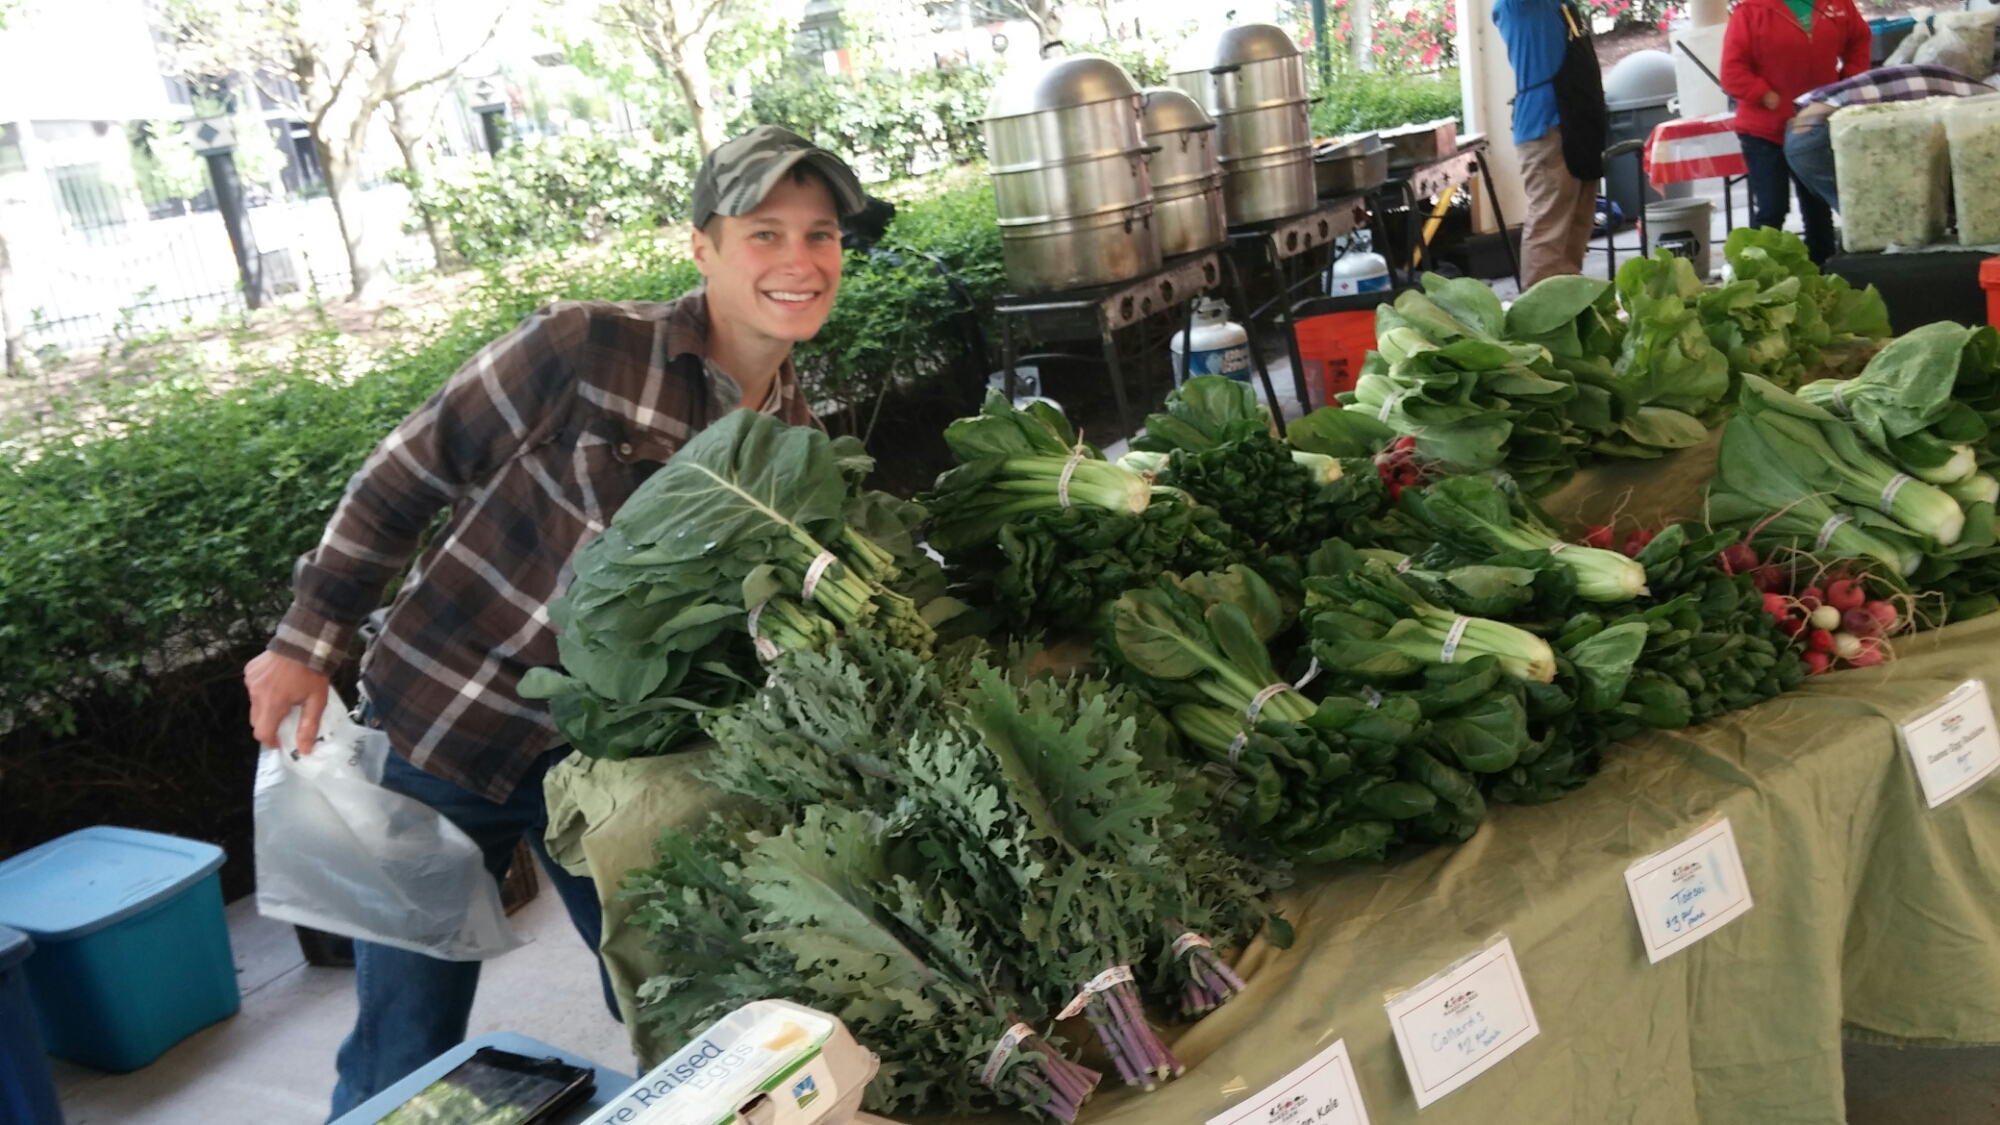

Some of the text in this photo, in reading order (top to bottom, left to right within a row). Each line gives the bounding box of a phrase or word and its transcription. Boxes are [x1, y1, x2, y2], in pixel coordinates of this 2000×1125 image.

[1670, 881, 1705, 906] Tatsoi
[1431, 1011, 1485, 1052] Collards
[629, 1039, 725, 1109] Raised
[685, 1043, 754, 1091] Eggs
[1316, 1097, 1339, 1120] Kale
